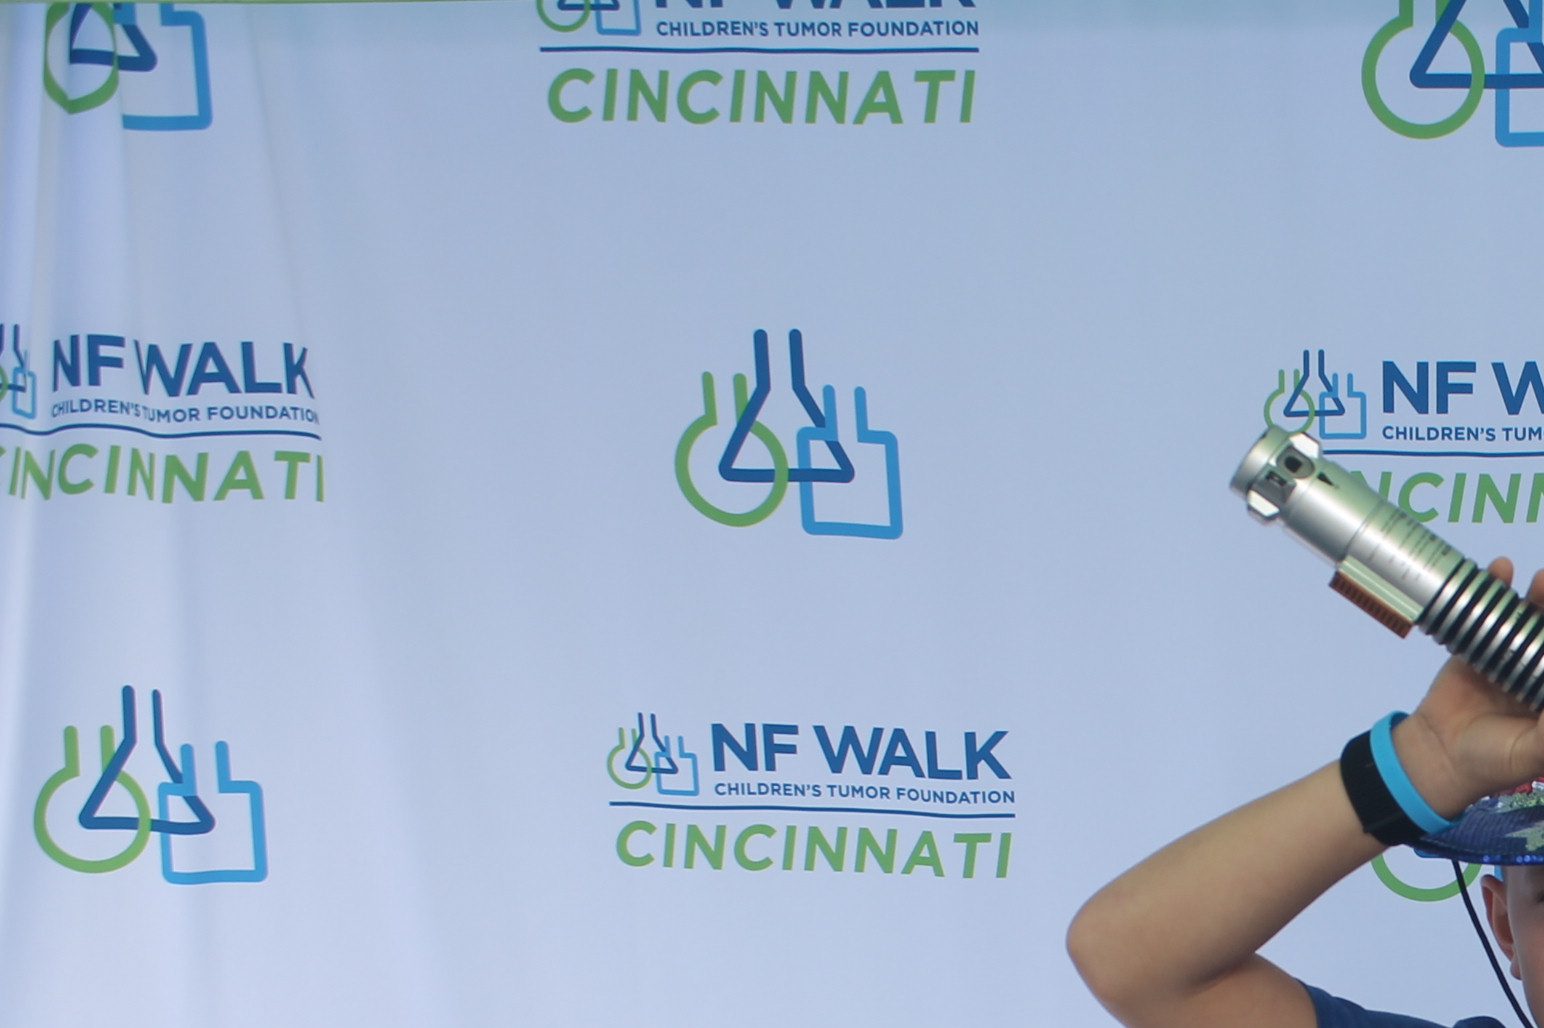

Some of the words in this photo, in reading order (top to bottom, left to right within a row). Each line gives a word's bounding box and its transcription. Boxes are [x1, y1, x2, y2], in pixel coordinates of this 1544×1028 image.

[656, 21, 769, 36] CHILDREN'S
[775, 21, 842, 37] TUMOR
[848, 21, 979, 37] FOUNDATION
[547, 68, 976, 125] CINCINNATI
[52, 334, 126, 392] NF
[134, 341, 315, 399] WALK
[1382, 360, 1477, 415] NF
[142, 405, 200, 422] TUMOR
[1382, 425, 1496, 442] CHILDREN'S
[0, 443, 324, 504] INCINNATI
[711, 722, 799, 772] NF
[812, 724, 1012, 781] WALK
[714, 782, 821, 798] CHILDREN'S
[827, 785, 890, 800] TUMOR
[896, 787, 1015, 805] FOUNDATION
[616, 820, 1012, 879] CINCINNATI
